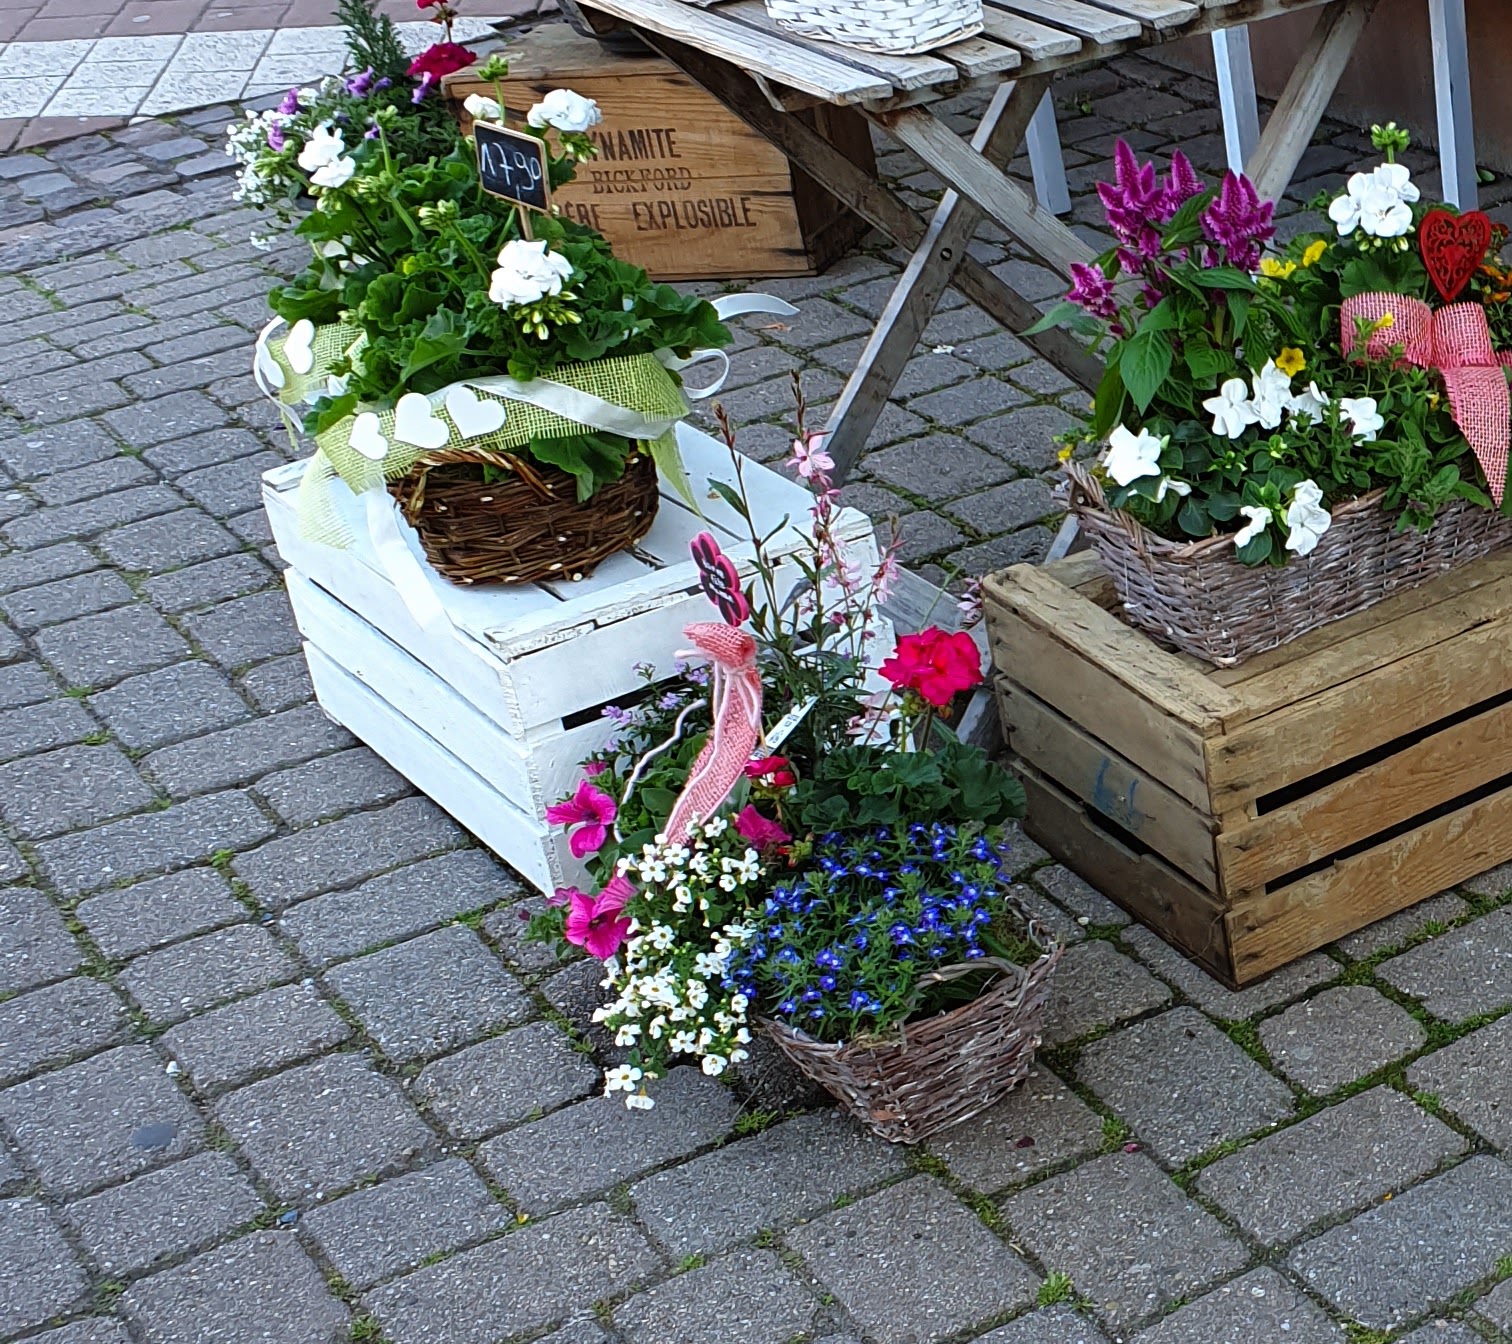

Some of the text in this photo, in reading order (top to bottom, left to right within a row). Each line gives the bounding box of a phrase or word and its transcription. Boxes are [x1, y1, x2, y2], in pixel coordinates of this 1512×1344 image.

[480, 141, 543, 200] 17,90
[590, 166, 692, 194] BICKFORD
[631, 196, 758, 232] EXPLOSIBLE
